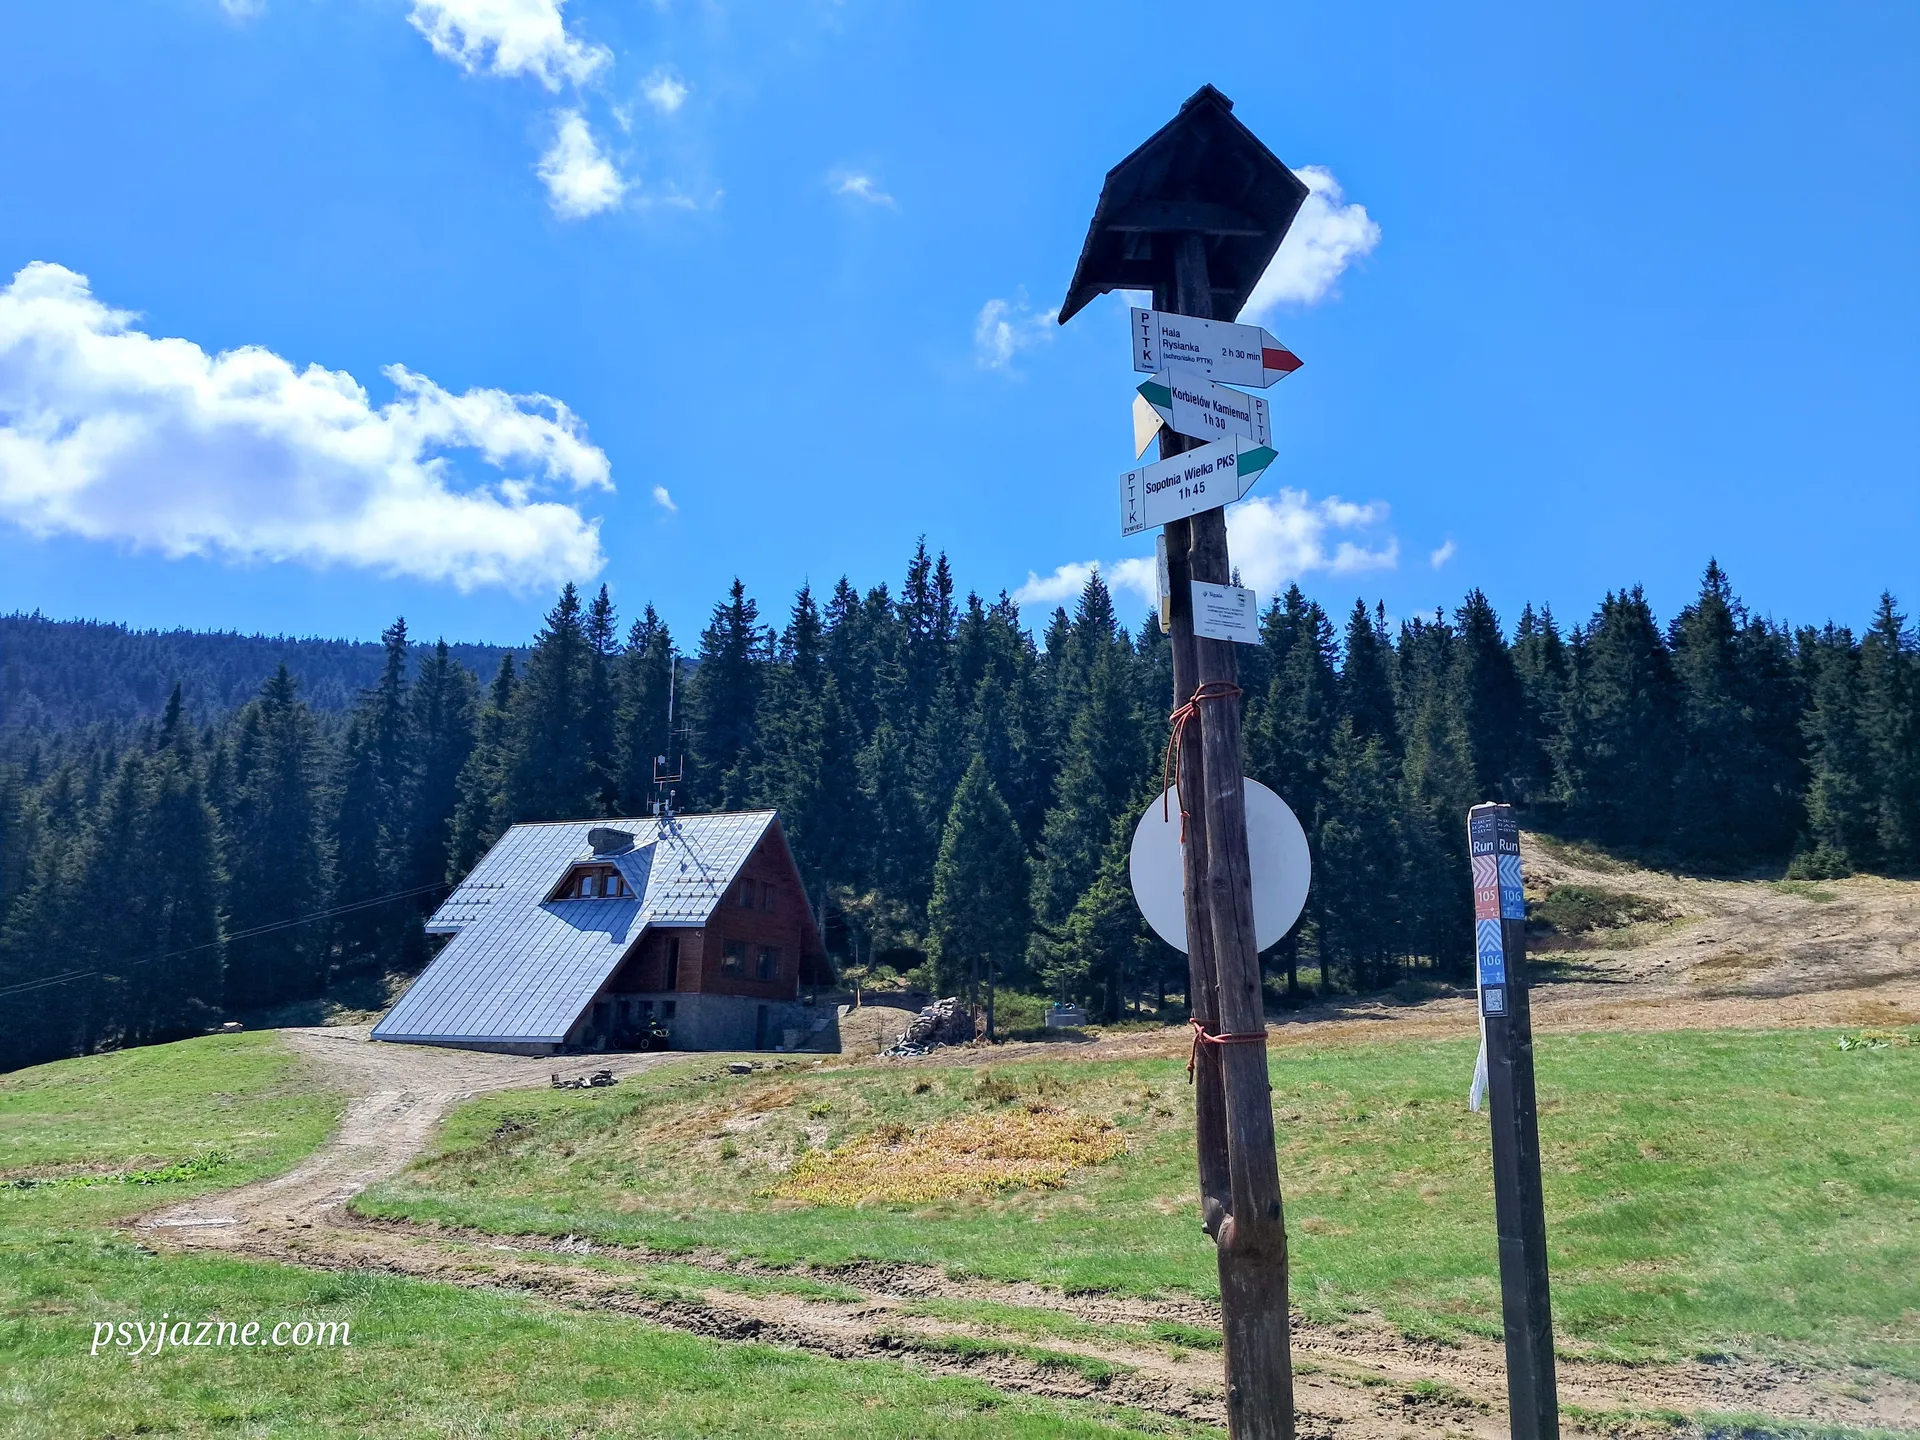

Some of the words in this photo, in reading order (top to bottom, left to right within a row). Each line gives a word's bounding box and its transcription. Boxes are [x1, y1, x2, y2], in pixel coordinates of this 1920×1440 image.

[1141, 312, 1152, 361] PTTK
[1162, 327, 1181, 338] Hala
[1162, 339, 1200, 352] Rysianka
[1222, 347, 1227, 356] 2
[1228, 348, 1234, 357] h
[1235, 349, 1245, 359] 30
[1247, 351, 1260, 361] min
[1172, 386, 1211, 408] Korbielów
[1212, 399, 1249, 421] Kamienna
[1203, 413, 1208, 424] 1
[1209, 415, 1214, 426] h
[1215, 417, 1226, 430] 30
[1146, 474, 1181, 494] Sopotnia
[1184, 463, 1213, 481] Wielka
[1216, 453, 1235, 470] PKS
[1179, 488, 1184, 500] 1
[1185, 486, 1191, 499] h
[1192, 481, 1206, 495] 45
[1128, 473, 1137, 524] PTTK
[1473, 841, 1494, 853] Run
[1499, 838, 1518, 852] Run
[1477, 890, 1496, 902] 105
[1503, 889, 1521, 902] 106
[1481, 954, 1501, 966] 106
